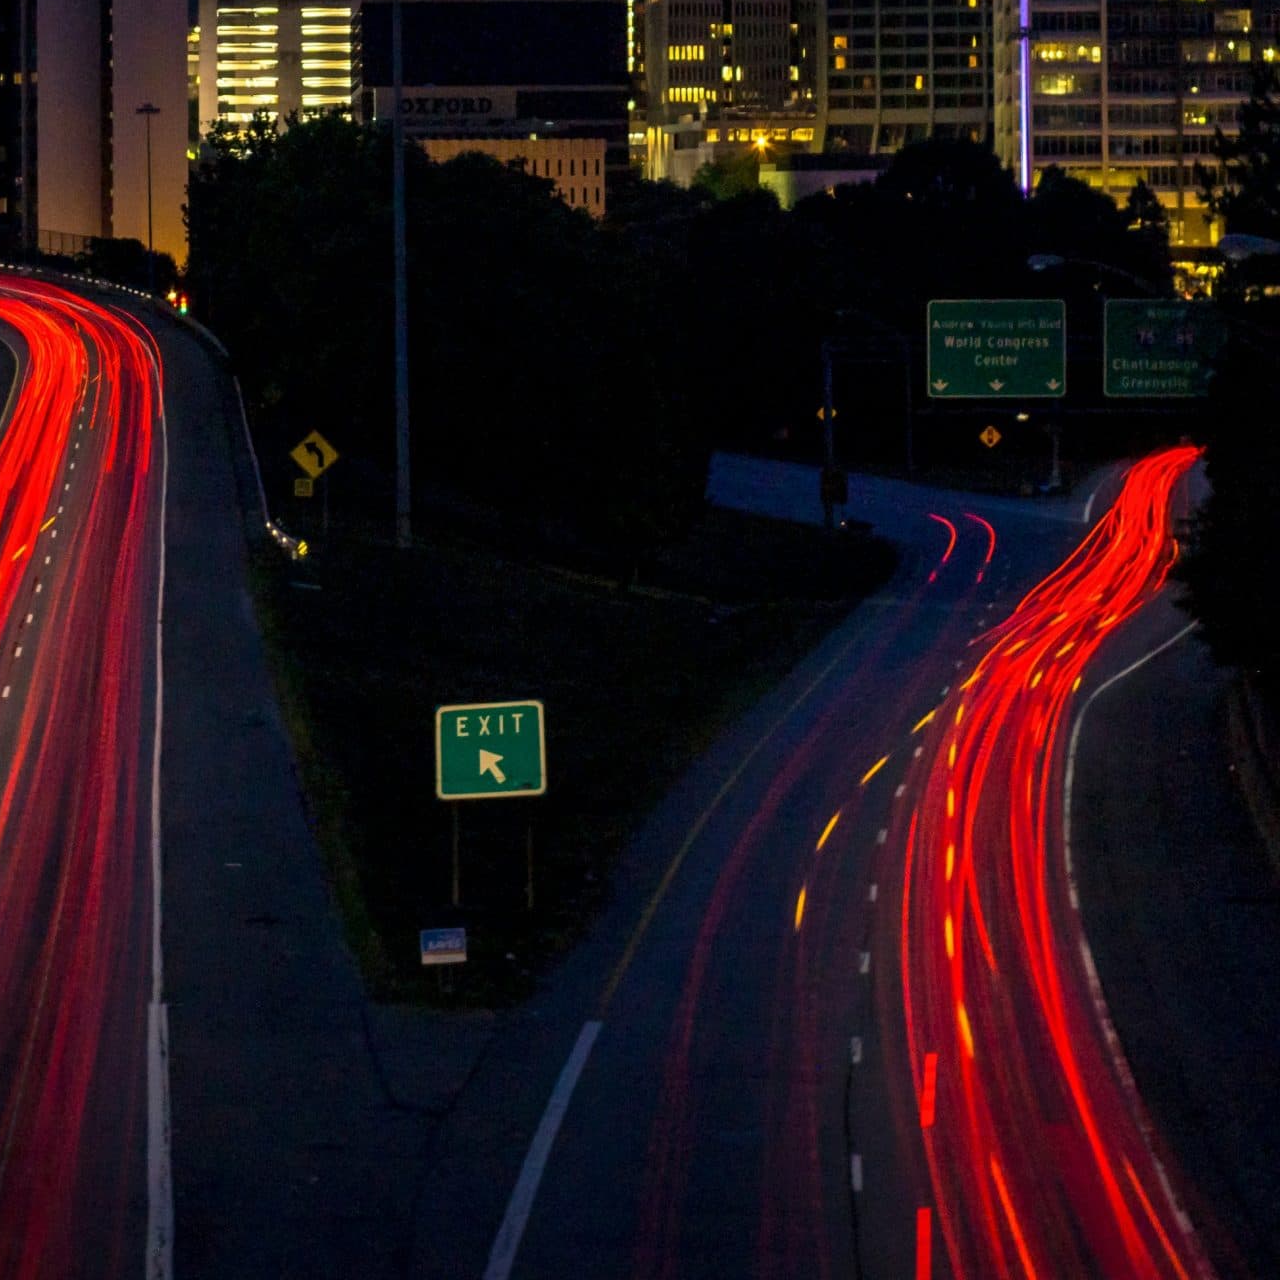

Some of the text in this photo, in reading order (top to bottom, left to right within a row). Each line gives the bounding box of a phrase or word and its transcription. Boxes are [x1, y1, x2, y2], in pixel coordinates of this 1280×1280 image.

[401, 97, 493, 114] OXFORD
[943, 335, 1049, 351] World Congress
[974, 354, 1019, 367] Center
[455, 713, 524, 737] EXIT
